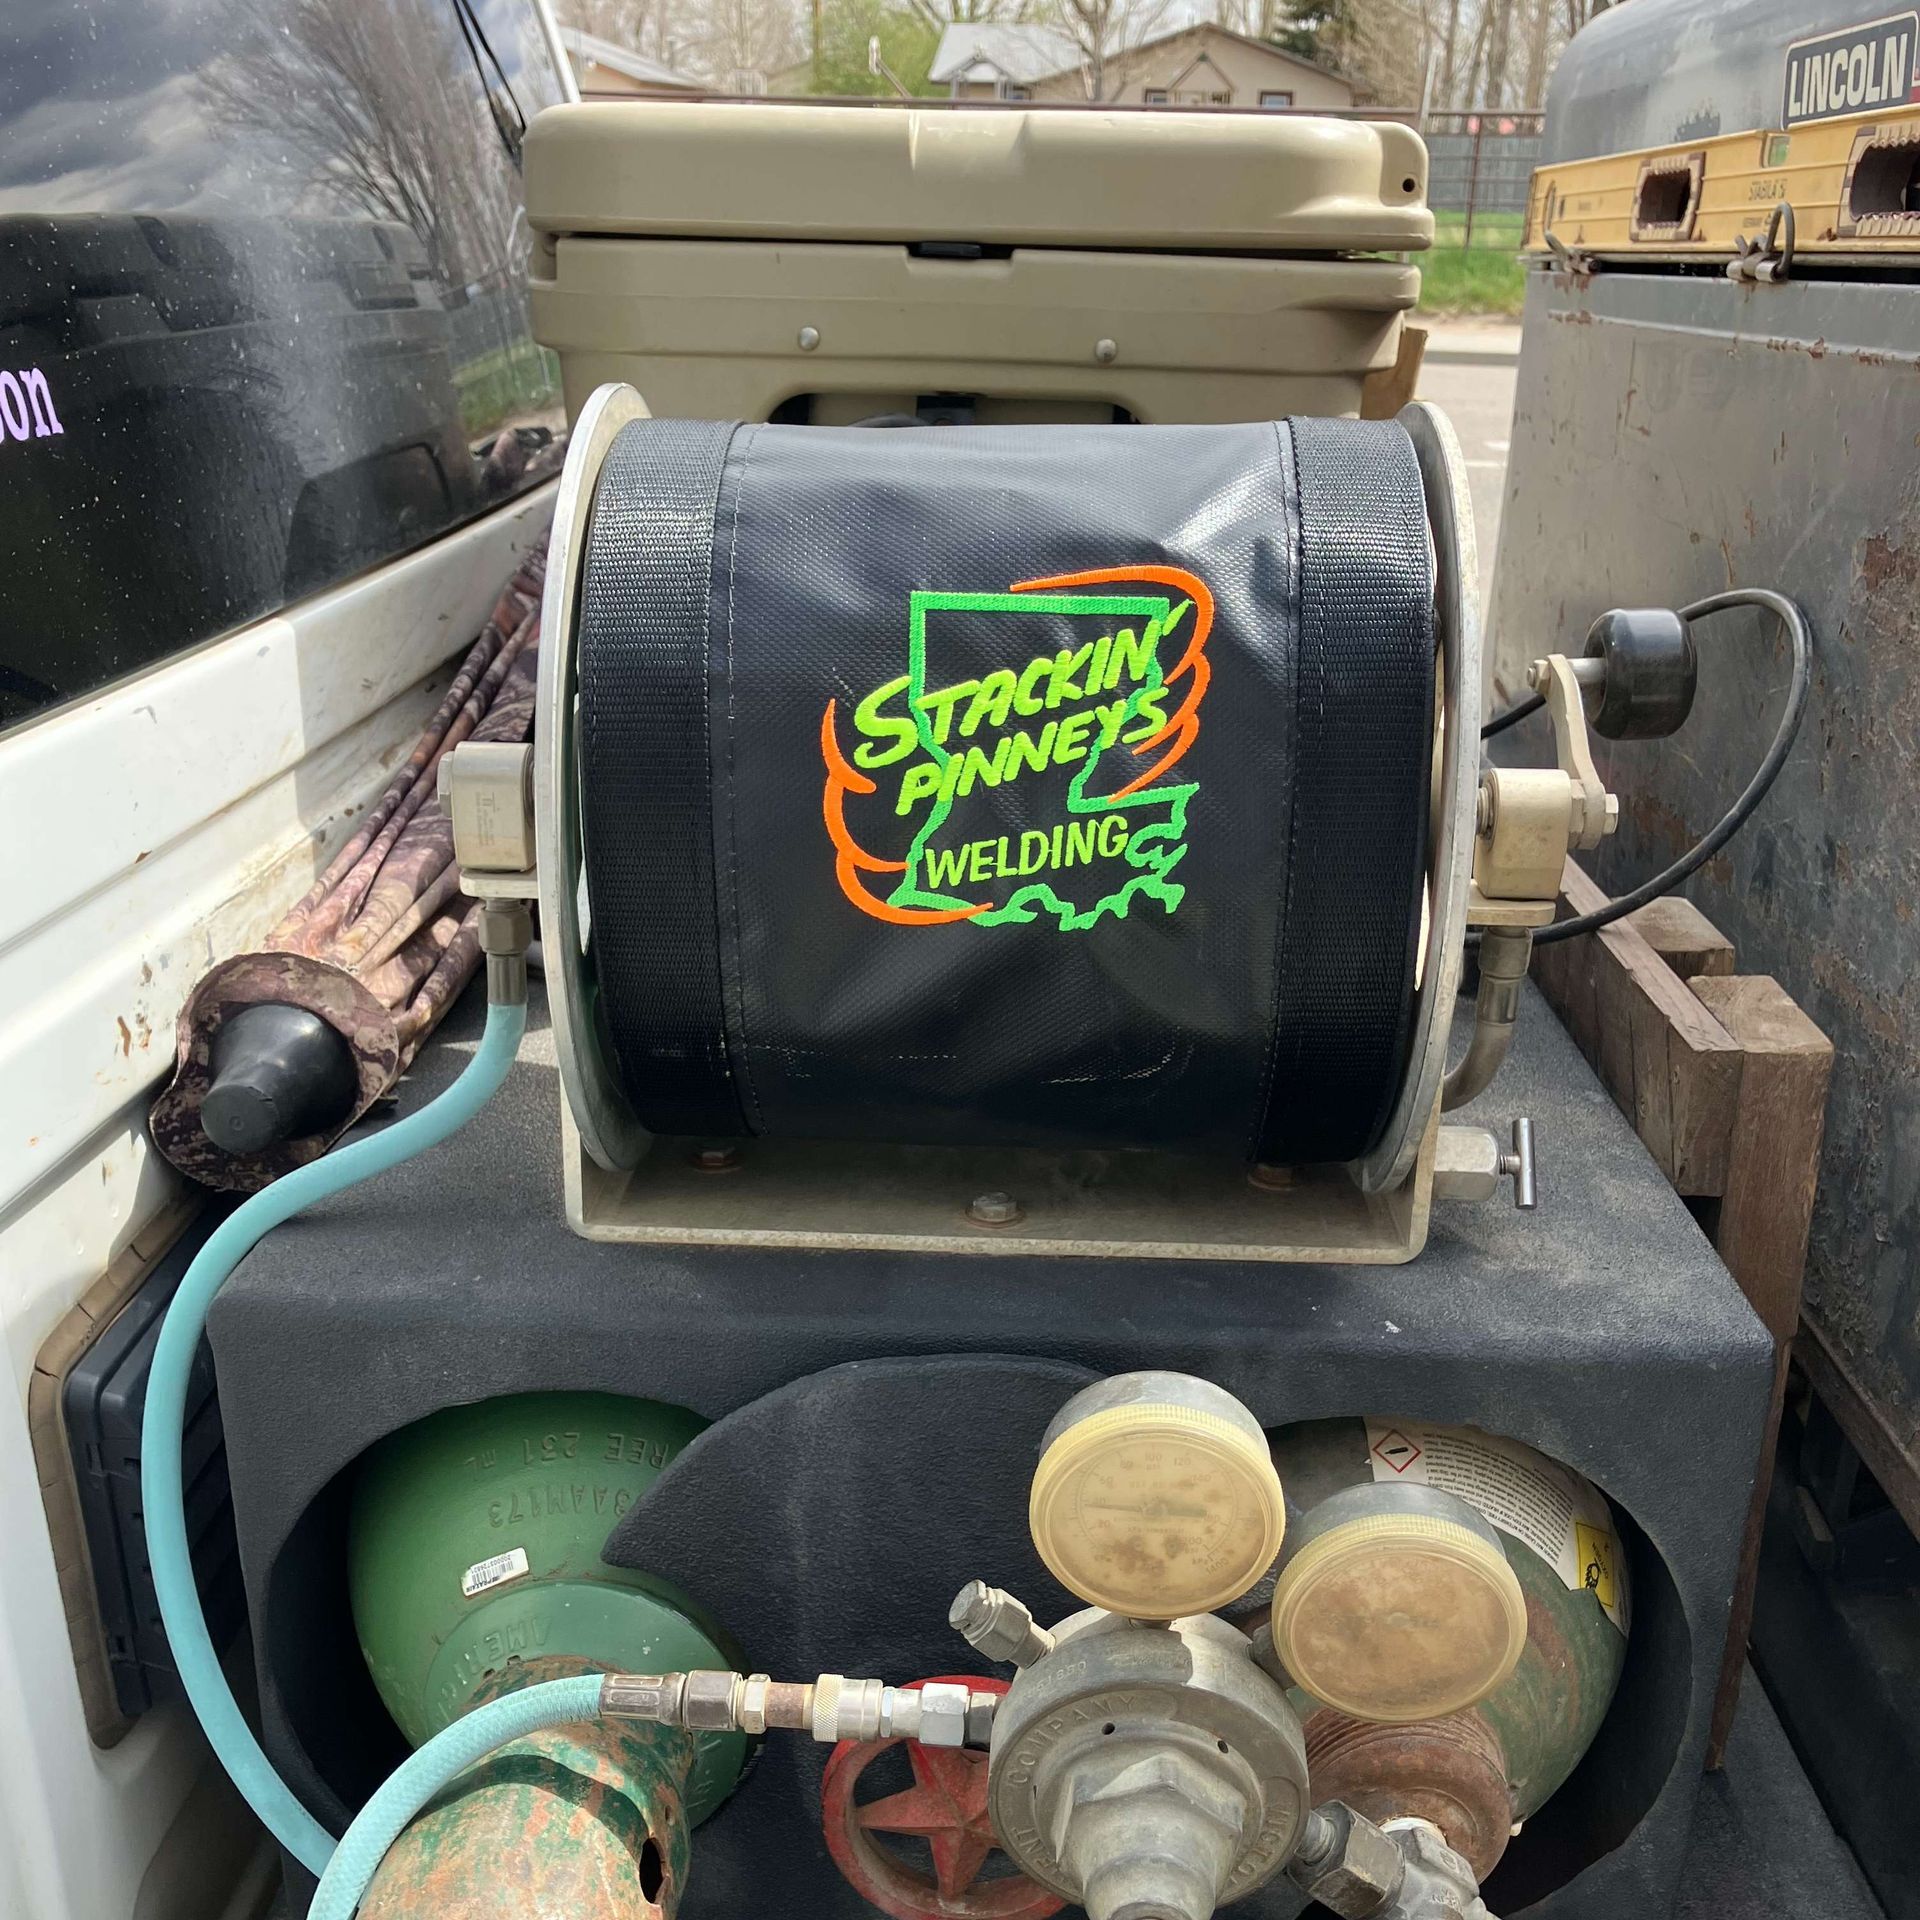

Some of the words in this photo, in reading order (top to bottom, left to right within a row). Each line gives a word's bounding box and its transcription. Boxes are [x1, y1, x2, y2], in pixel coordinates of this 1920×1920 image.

[1788, 32, 1908, 118] LINCOLN
[0, 367, 64, 443] on
[895, 687, 1169, 816] PINNEYS
[925, 814, 1130, 889] WELDING
[1007, 1693, 1135, 1785] COMPANY
